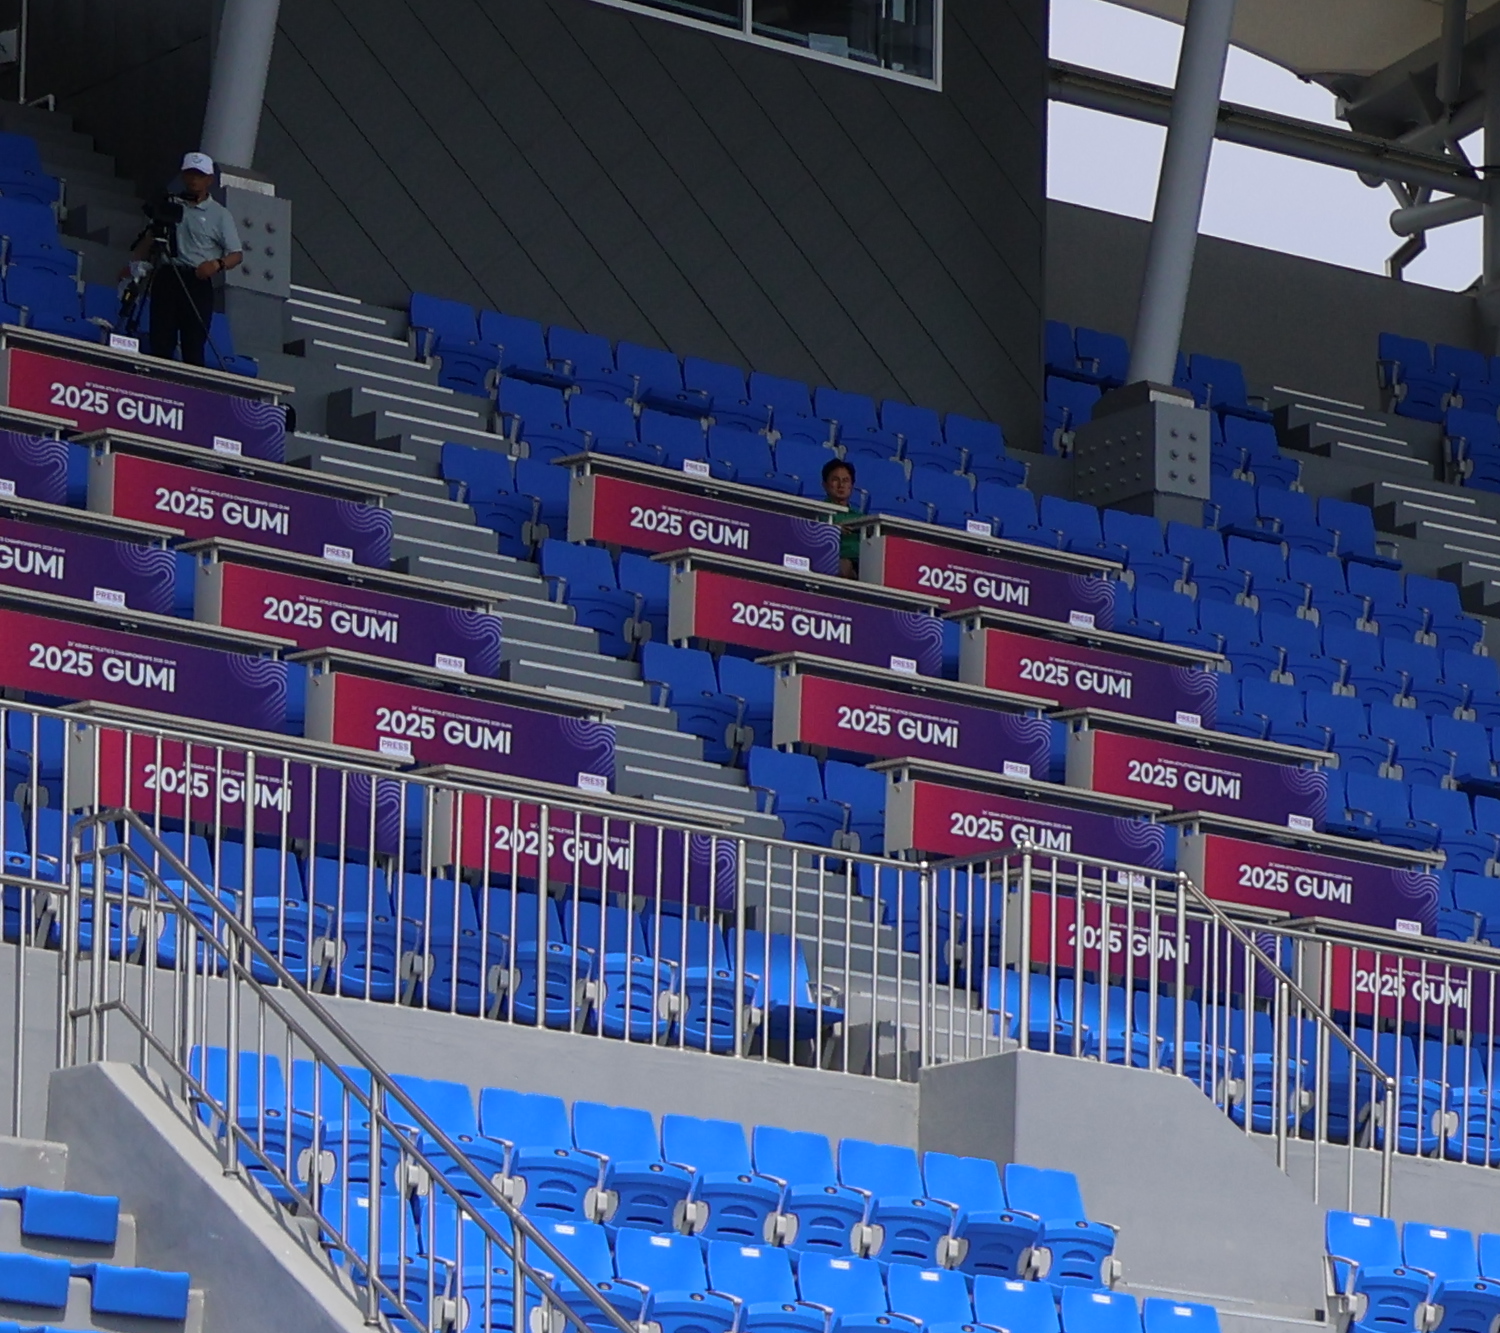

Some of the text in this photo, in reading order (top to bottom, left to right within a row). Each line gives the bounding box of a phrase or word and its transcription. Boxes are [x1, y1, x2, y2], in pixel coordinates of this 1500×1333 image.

[51, 382, 109, 415] 2025
[116, 397, 184, 431] GUMI
[155, 487, 214, 520] 2025
[221, 501, 289, 535] GUMI
[630, 506, 682, 536] 2025
[689, 519, 749, 550] GUMI
[0, 544, 64, 580] GUMI
[918, 565, 967, 594] 2025
[973, 577, 1029, 606] GUMI
[263, 596, 323, 629] 2025
[330, 610, 398, 644] GUMI
[732, 602, 785, 632] 2025
[791, 614, 851, 645] GUMI
[29, 643, 94, 677] 2025
[102, 657, 175, 693] GUMI
[1019, 658, 1069, 687] 2025
[1075, 669, 1131, 699] GUMI
[375, 707, 436, 740] 2025
[443, 720, 511, 755] GUMI
[837, 706, 891, 736] 2025
[897, 717, 958, 749] GUMI
[144, 763, 209, 798] 2025
[220, 778, 292, 813] GUMI
[1128, 760, 1178, 789] 2025
[1183, 770, 1241, 800] GUMI
[494, 825, 555, 858] 2025
[563, 838, 631, 871] GUMI
[950, 812, 1004, 842] 2025
[1010, 823, 1071, 853] GUMI
[1238, 864, 1289, 893] 2025
[1295, 874, 1352, 904] GUMI
[1068, 924, 1122, 953] 2025
[1130, 933, 1190, 965] GUMI
[1355, 970, 1406, 998] 2025
[1411, 979, 1468, 1009] GUMI
